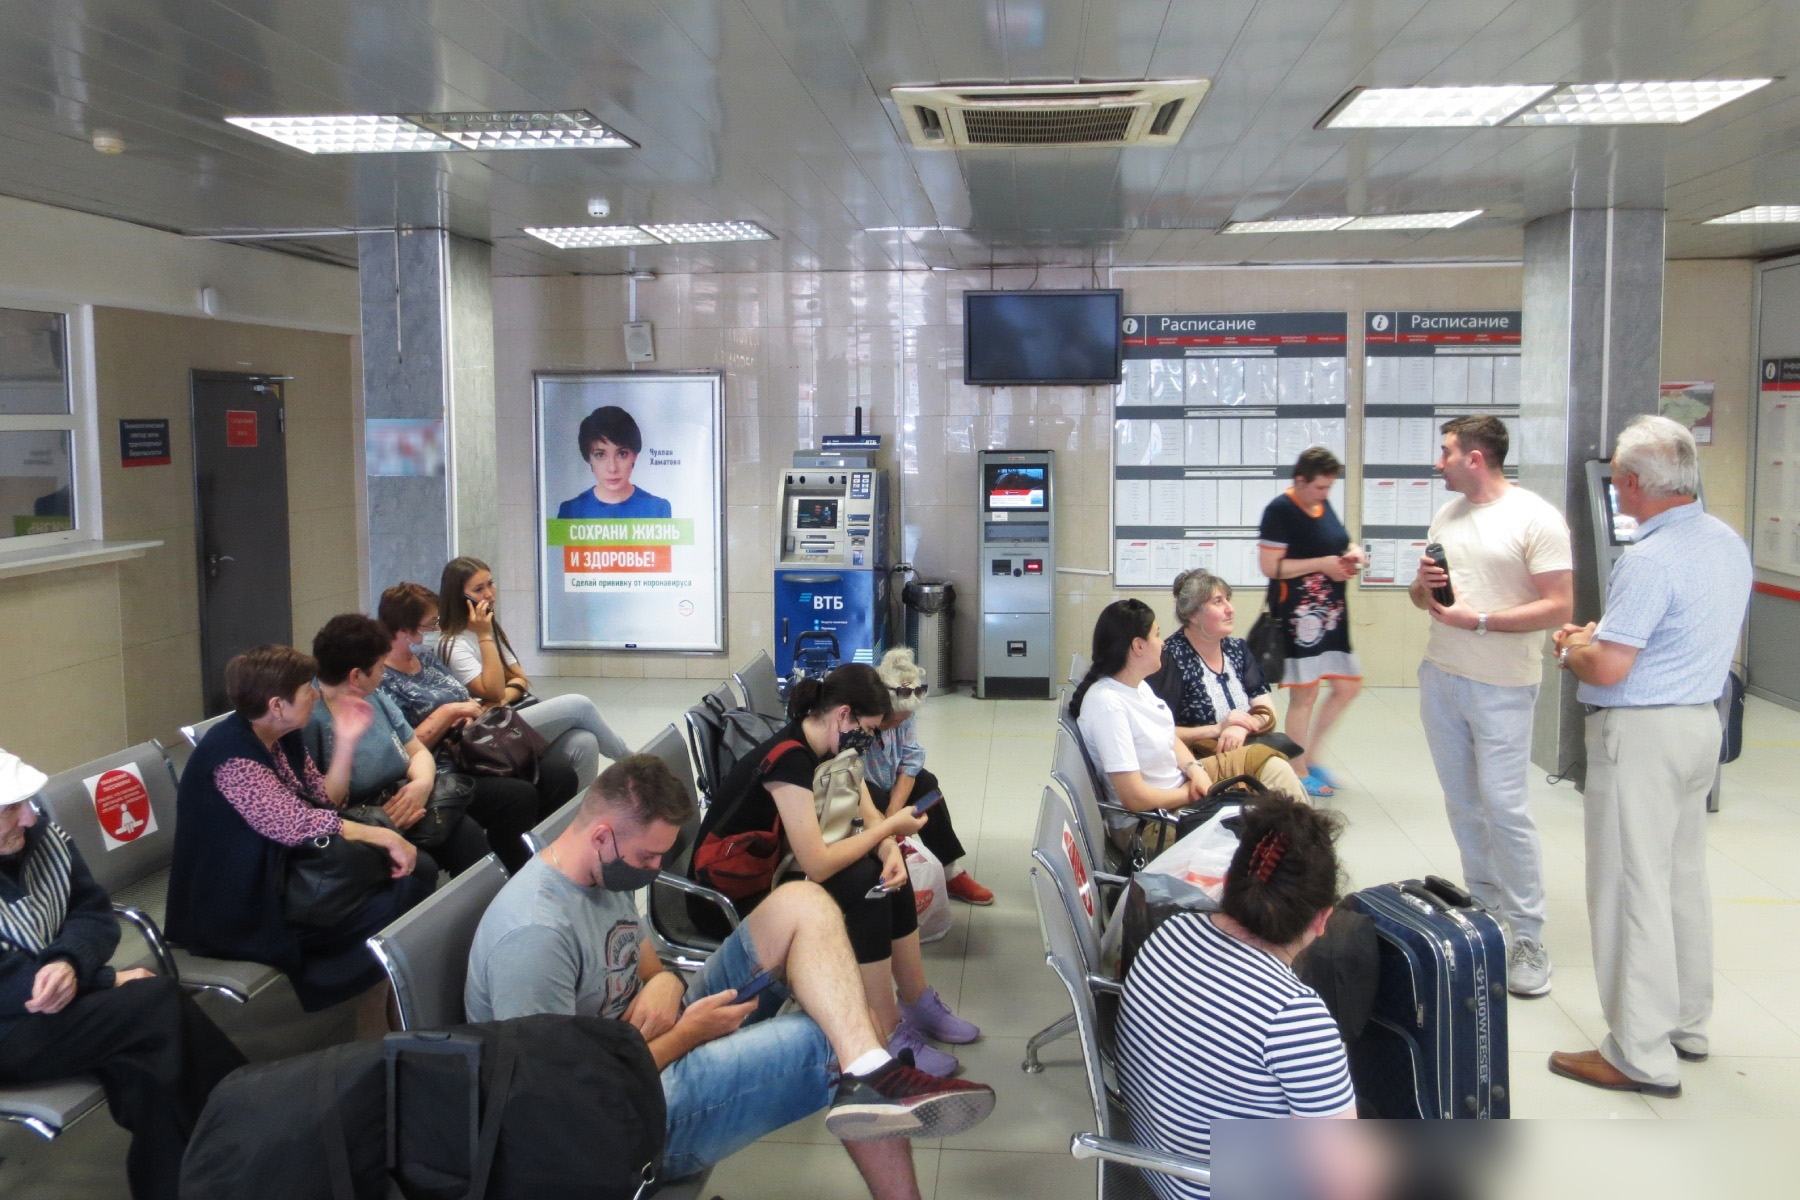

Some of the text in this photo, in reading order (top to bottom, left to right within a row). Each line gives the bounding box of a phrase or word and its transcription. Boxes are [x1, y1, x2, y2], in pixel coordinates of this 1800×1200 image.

[1161, 317, 1257, 331] Расписание
[1411, 315, 1510, 329] Расписание
[649, 448, 674, 457] Чулпан
[650, 458, 681, 466] Хаматова
[569, 523, 680, 540] СОХРАНИ ЖИЗНЬ
[570, 551, 655, 569] И ЗДОРОВЬЕ!
[571, 578, 597, 588] Сделай
[598, 579, 632, 588] прививку
[643, 579, 692, 588] коронавируса
[813, 595, 844, 610] ВТБ
[1475, 986, 1489, 1085] LUOWEESER
